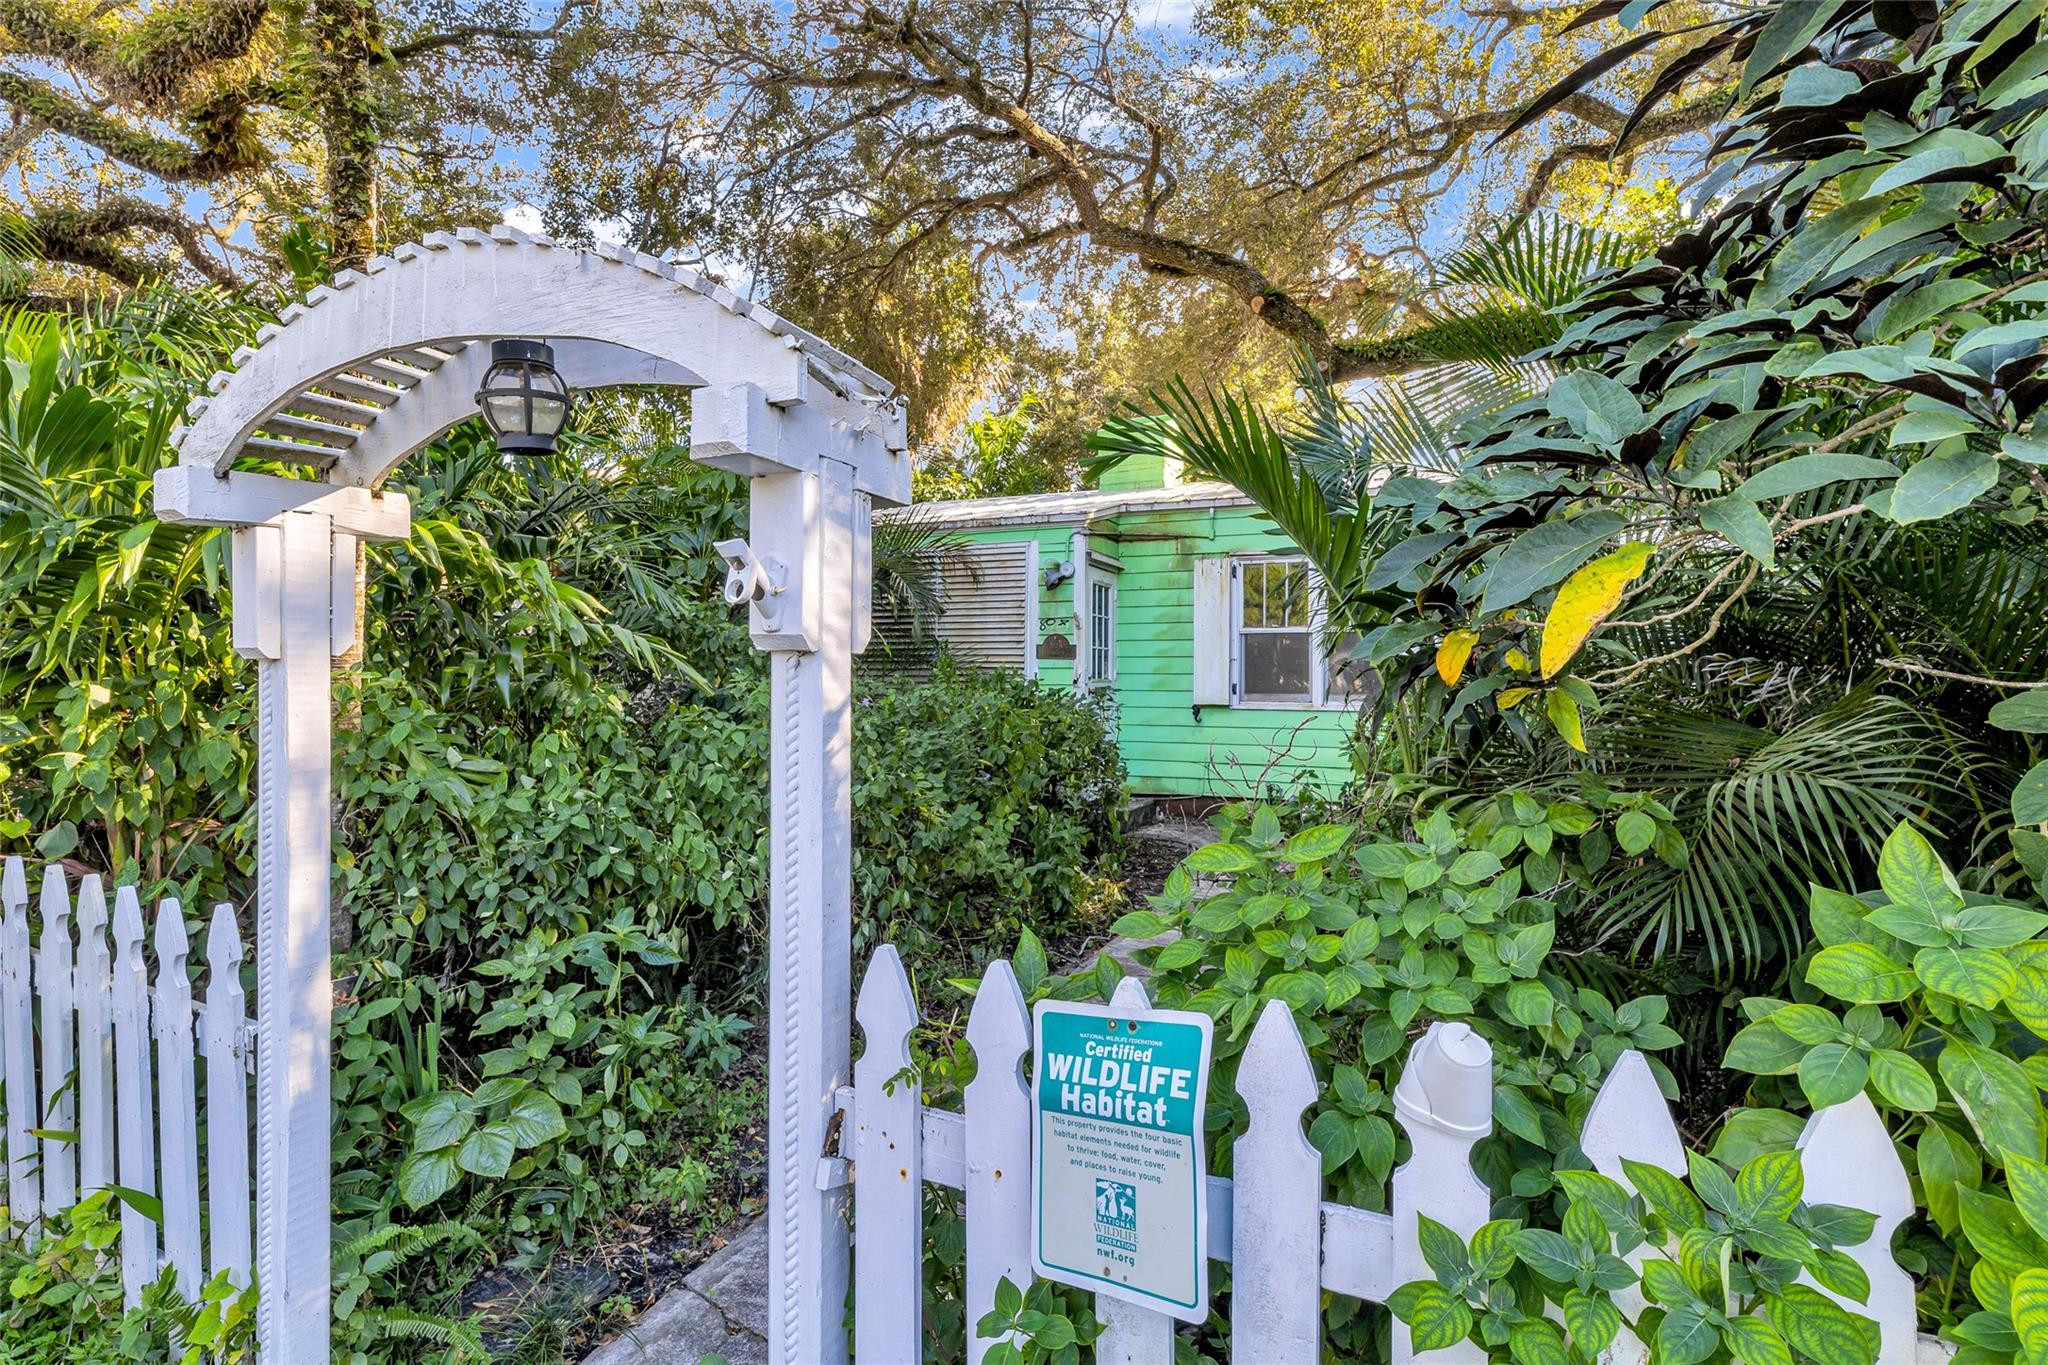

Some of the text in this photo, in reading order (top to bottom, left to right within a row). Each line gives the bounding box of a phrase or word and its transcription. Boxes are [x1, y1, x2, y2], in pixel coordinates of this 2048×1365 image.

[1079, 1032, 1105, 1041] NATIONAL
[1105, 1035, 1128, 1044] WILDLIFE
[1085, 1041, 1153, 1063] Certified
[1048, 1052, 1192, 1100] WILDLIFE
[1051, 1115, 1183, 1147] This property provides the four basic
[1053, 1128, 1181, 1160] habitat elements needed for wildlife
[1067, 1144, 1167, 1172] to thrive: food, water, cover,
[1070, 1158, 1164, 1185] and places to raise young.
[1093, 1222, 1140, 1244] WILDLIFE
[1097, 1215, 1136, 1231] NATIONAL
[1097, 1235, 1136, 1252] FEDERATION
[1096, 1247, 1136, 1268] nwf.org
